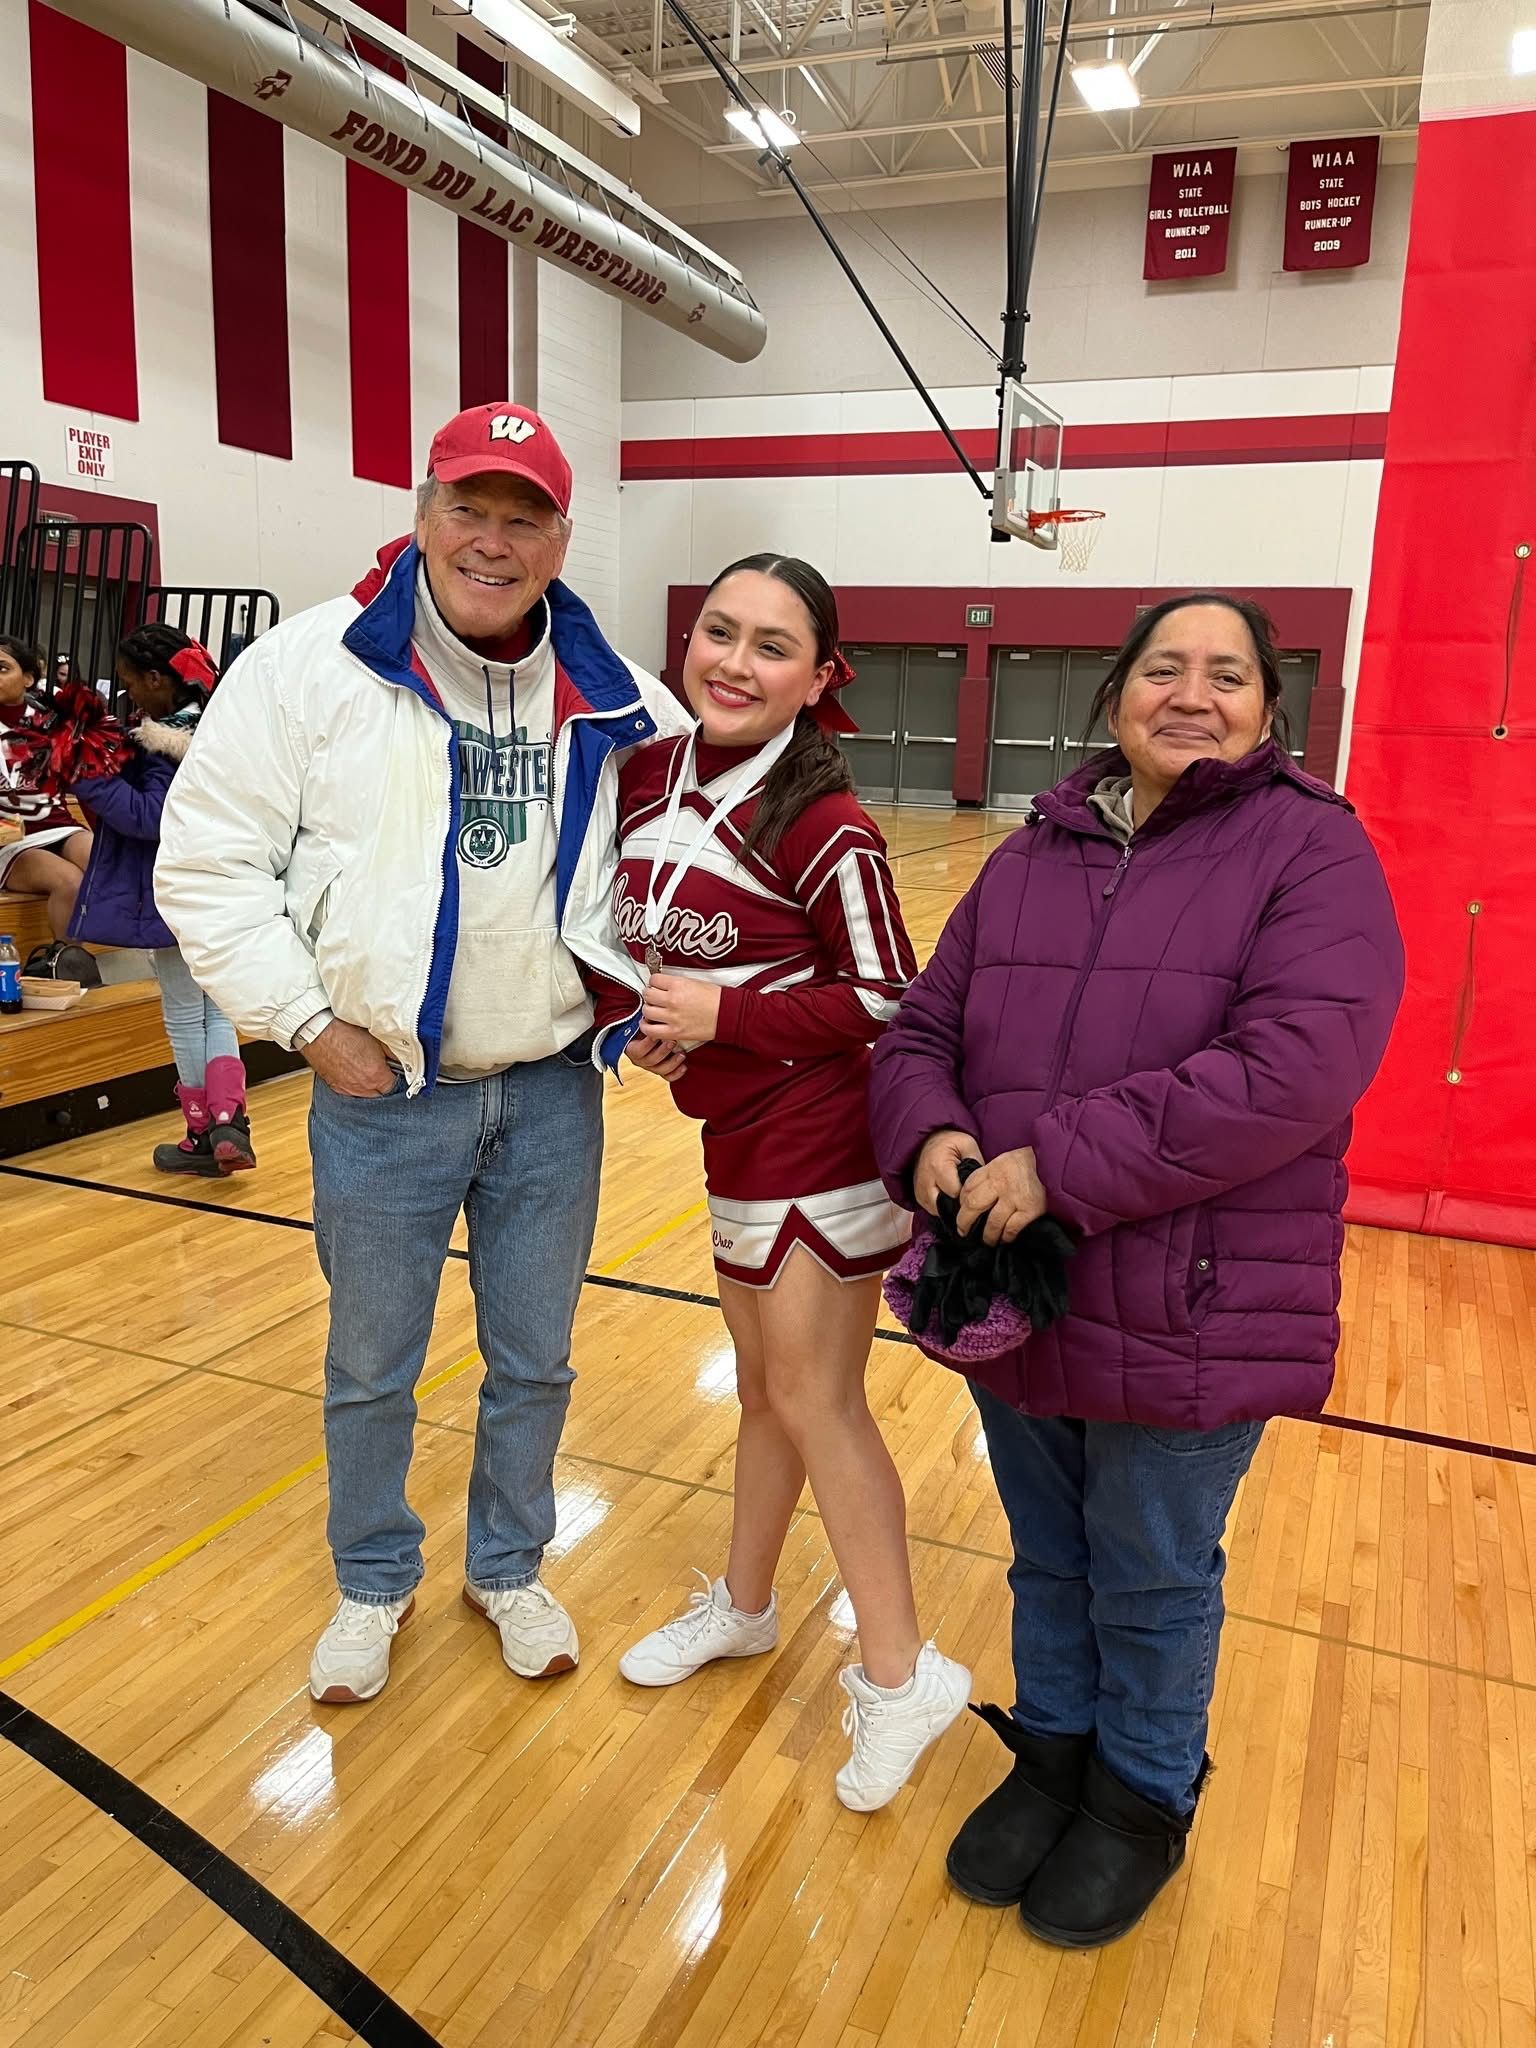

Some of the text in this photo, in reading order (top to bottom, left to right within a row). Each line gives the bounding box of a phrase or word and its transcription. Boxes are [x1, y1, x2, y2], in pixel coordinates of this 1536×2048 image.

[1312, 151, 1355, 169] WIAA
[1173, 161, 1213, 178] WIAA
[1319, 178, 1344, 189] STATE
[1179, 187, 1203, 198] STATE
[329, 110, 667, 304] FOND DU LAC WRESTLING
[1300, 196, 1360, 211] BOYS HOCKEY
[1149, 204, 1229, 220] GIRLS VOLLEYBALL
[1305, 217, 1352, 231] RUNNER-UP
[1165, 225, 1210, 239] RUNNER-UP
[1313, 240, 1341, 251] 2009
[1174, 248, 1197, 260] 2011
[489, 414, 537, 445] W
[68, 427, 111, 449] PLAYER
[78, 445, 103, 462] EXIT
[77, 459, 105, 477] ONLY
[971, 610, 988, 623] EXIT
